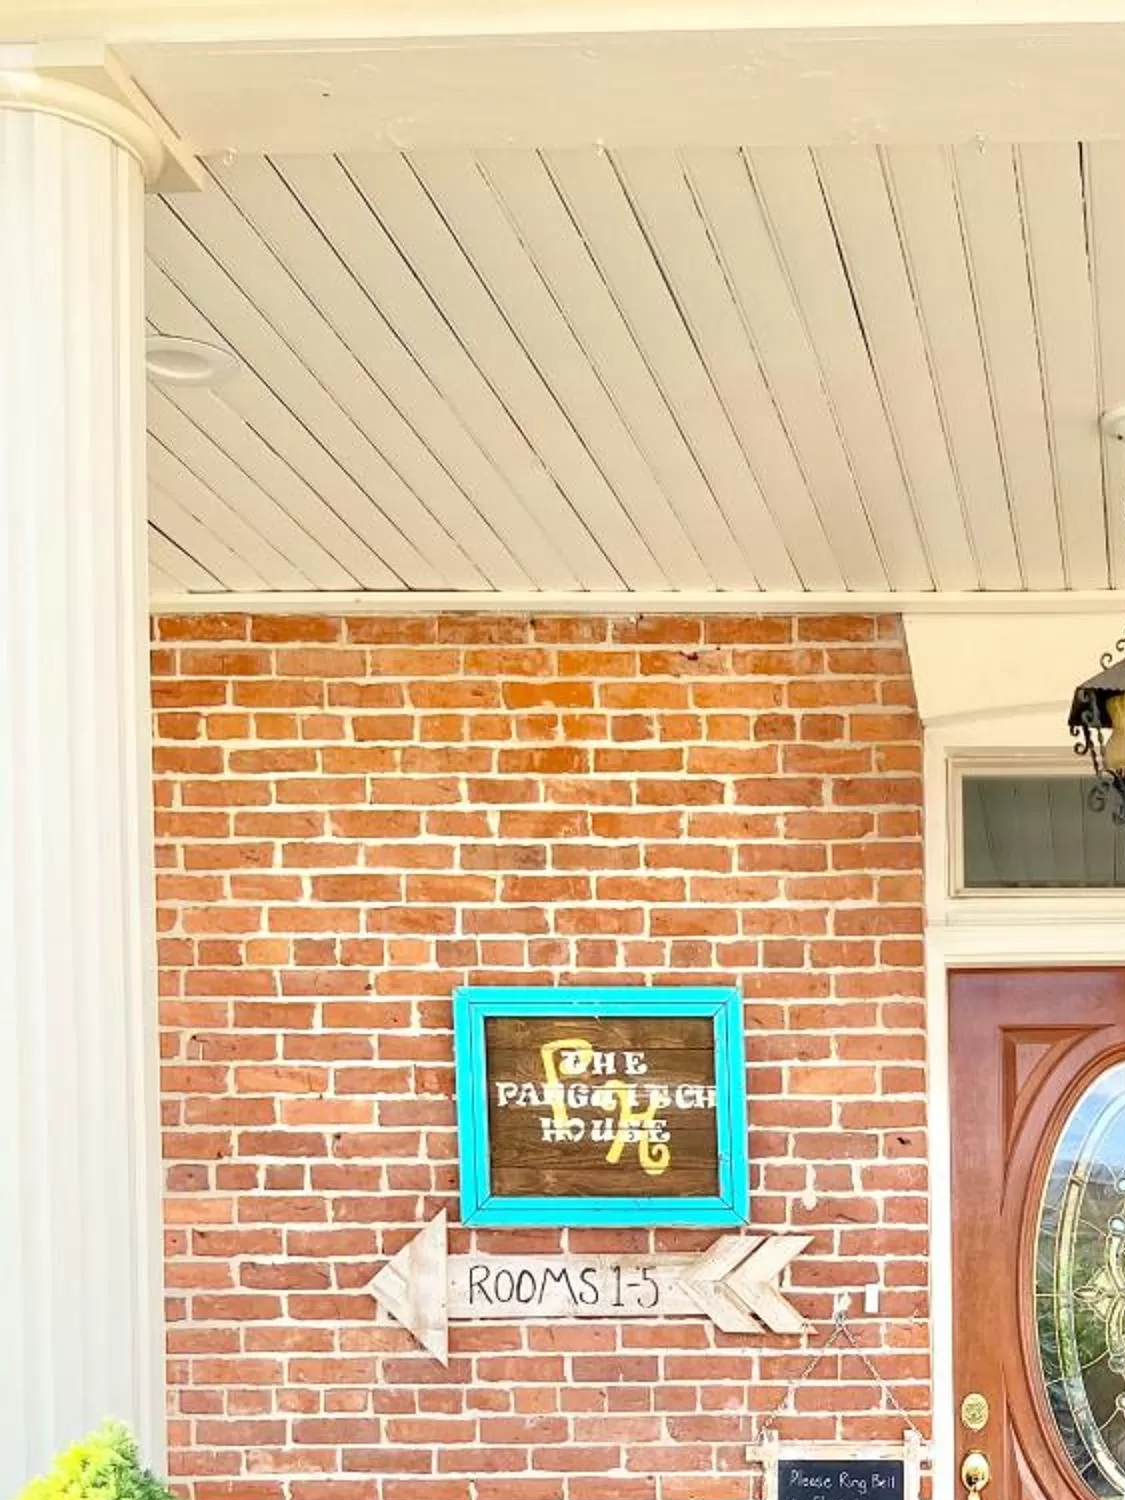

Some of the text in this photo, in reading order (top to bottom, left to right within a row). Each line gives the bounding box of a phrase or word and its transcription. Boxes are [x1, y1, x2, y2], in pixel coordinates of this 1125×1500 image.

[468, 1264, 660, 1309] ROOMS 1-5
[789, 1469, 896, 1495] Please Ring Bell
